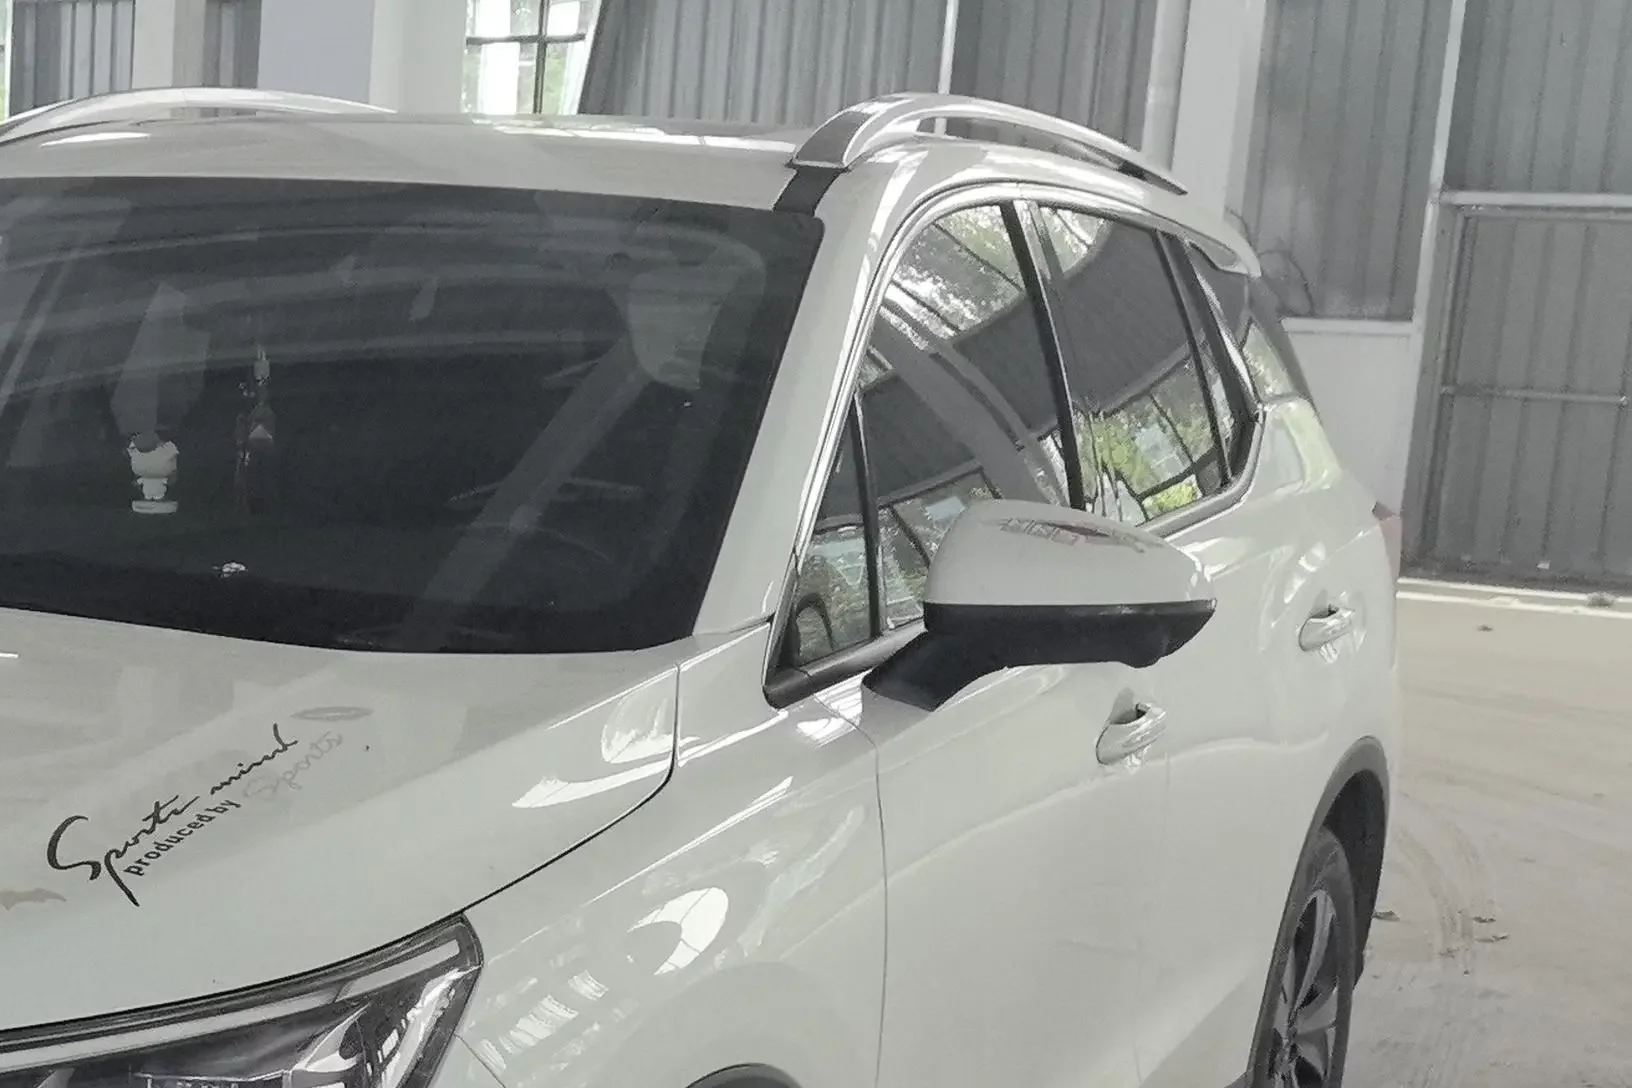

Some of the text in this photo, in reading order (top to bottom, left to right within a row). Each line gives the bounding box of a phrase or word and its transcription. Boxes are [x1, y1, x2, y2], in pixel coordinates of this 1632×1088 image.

[210, 722, 298, 795] mind
[124, 813, 216, 876] produced
[205, 799, 241, 814] by
